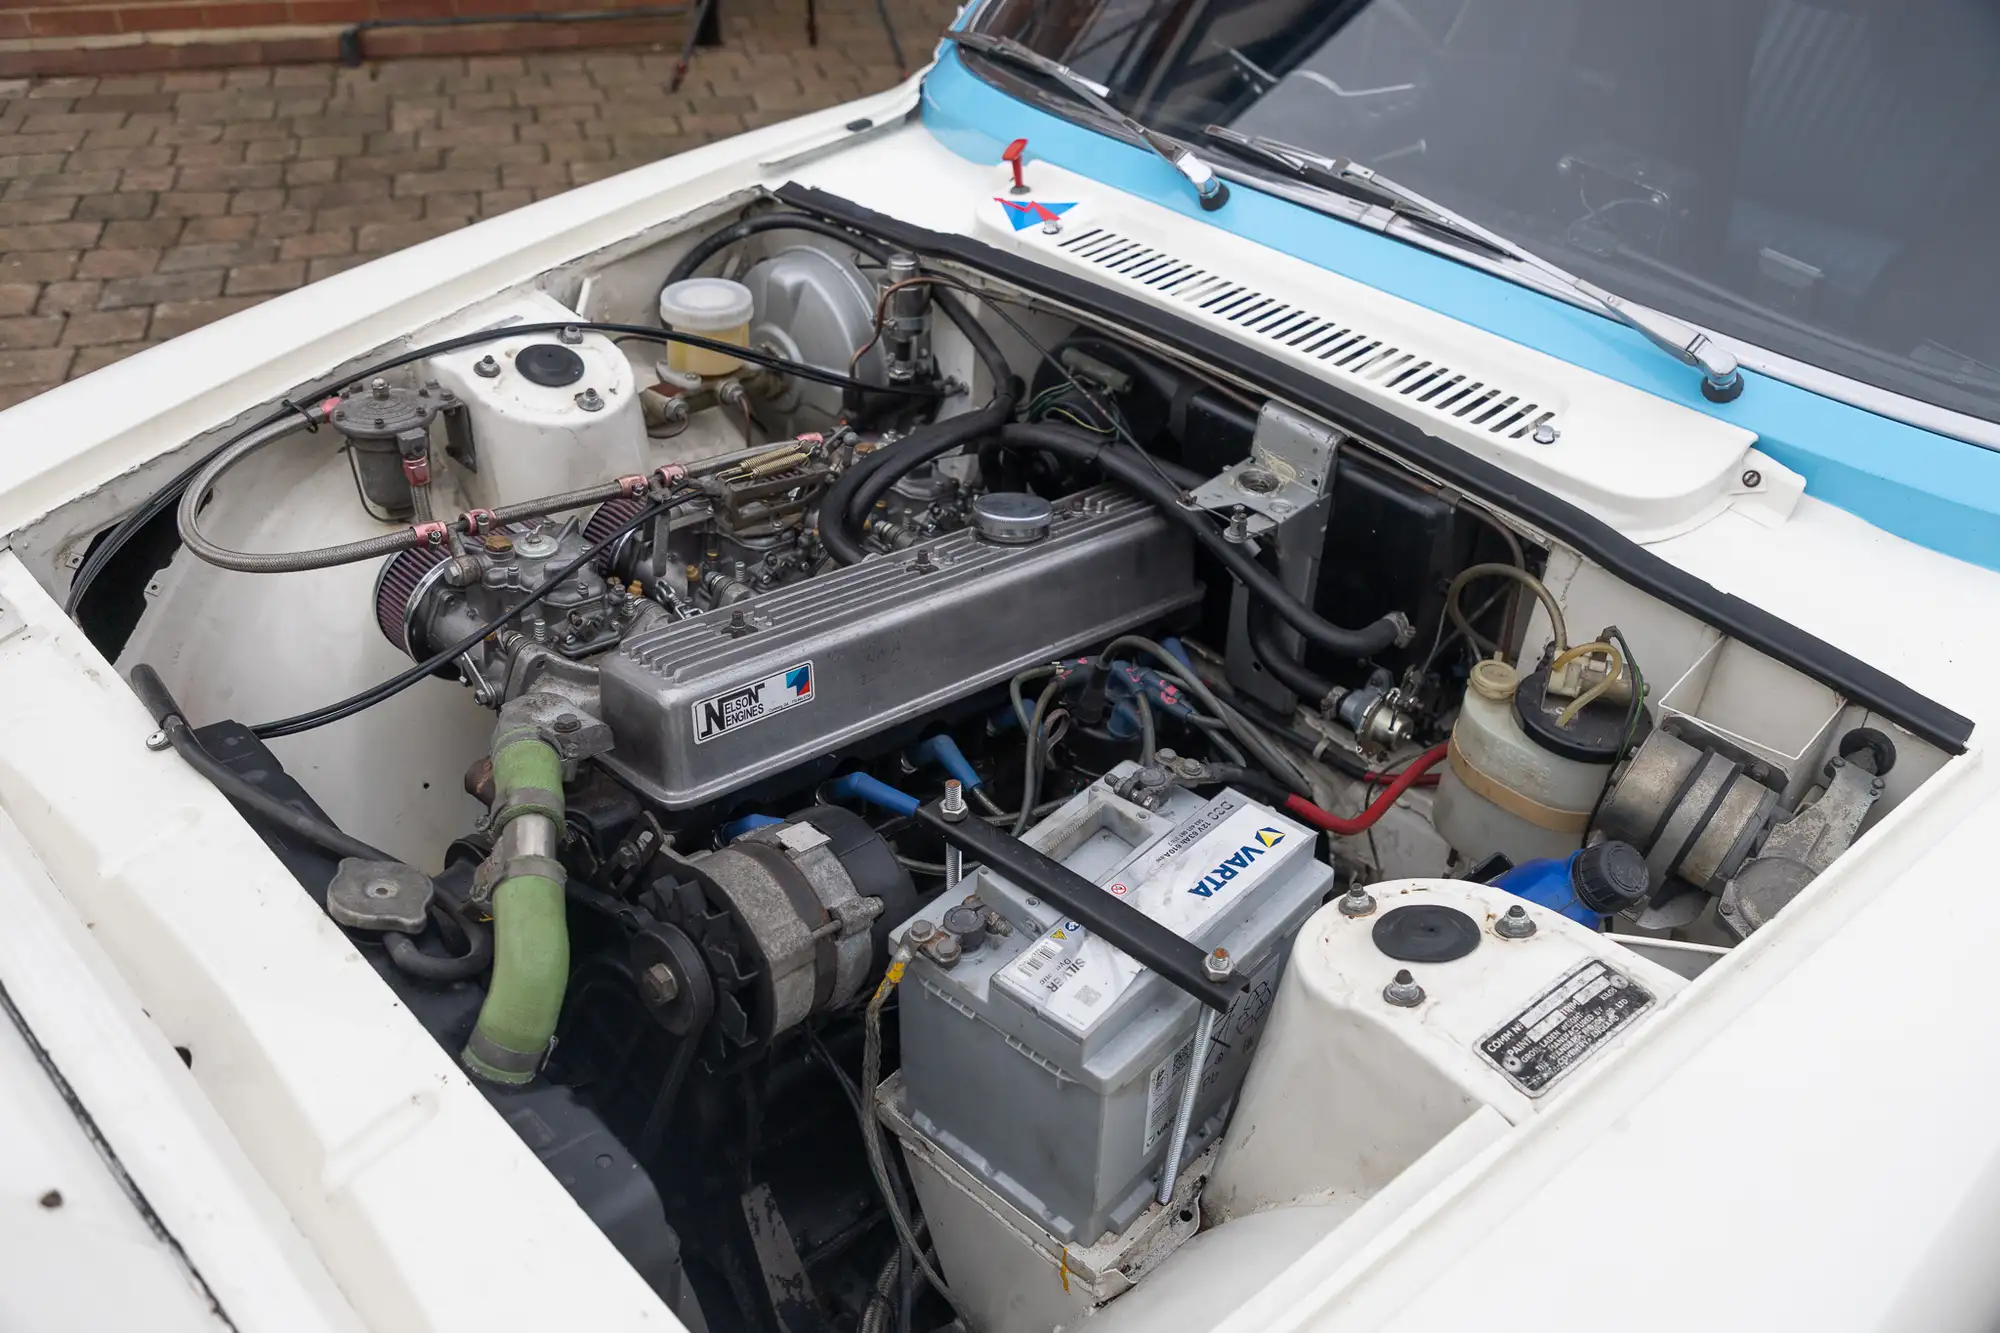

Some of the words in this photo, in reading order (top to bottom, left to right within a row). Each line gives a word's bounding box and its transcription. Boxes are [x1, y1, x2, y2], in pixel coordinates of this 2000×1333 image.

[701, 683, 765, 738] NELSON
[726, 703, 764, 728] ENGINES
[1198, 821, 1211, 833] 12V
[1187, 845, 1266, 898] VARTA
[1046, 958, 1086, 993] SILVER
[1487, 1030, 1515, 1052] COMM
[1506, 1036, 1533, 1056] PAINT
[1560, 999, 1581, 1016] TRIM
[1540, 1030, 1561, 1048] LADEN
[1548, 1014, 1595, 1051] MANUFACTURED
